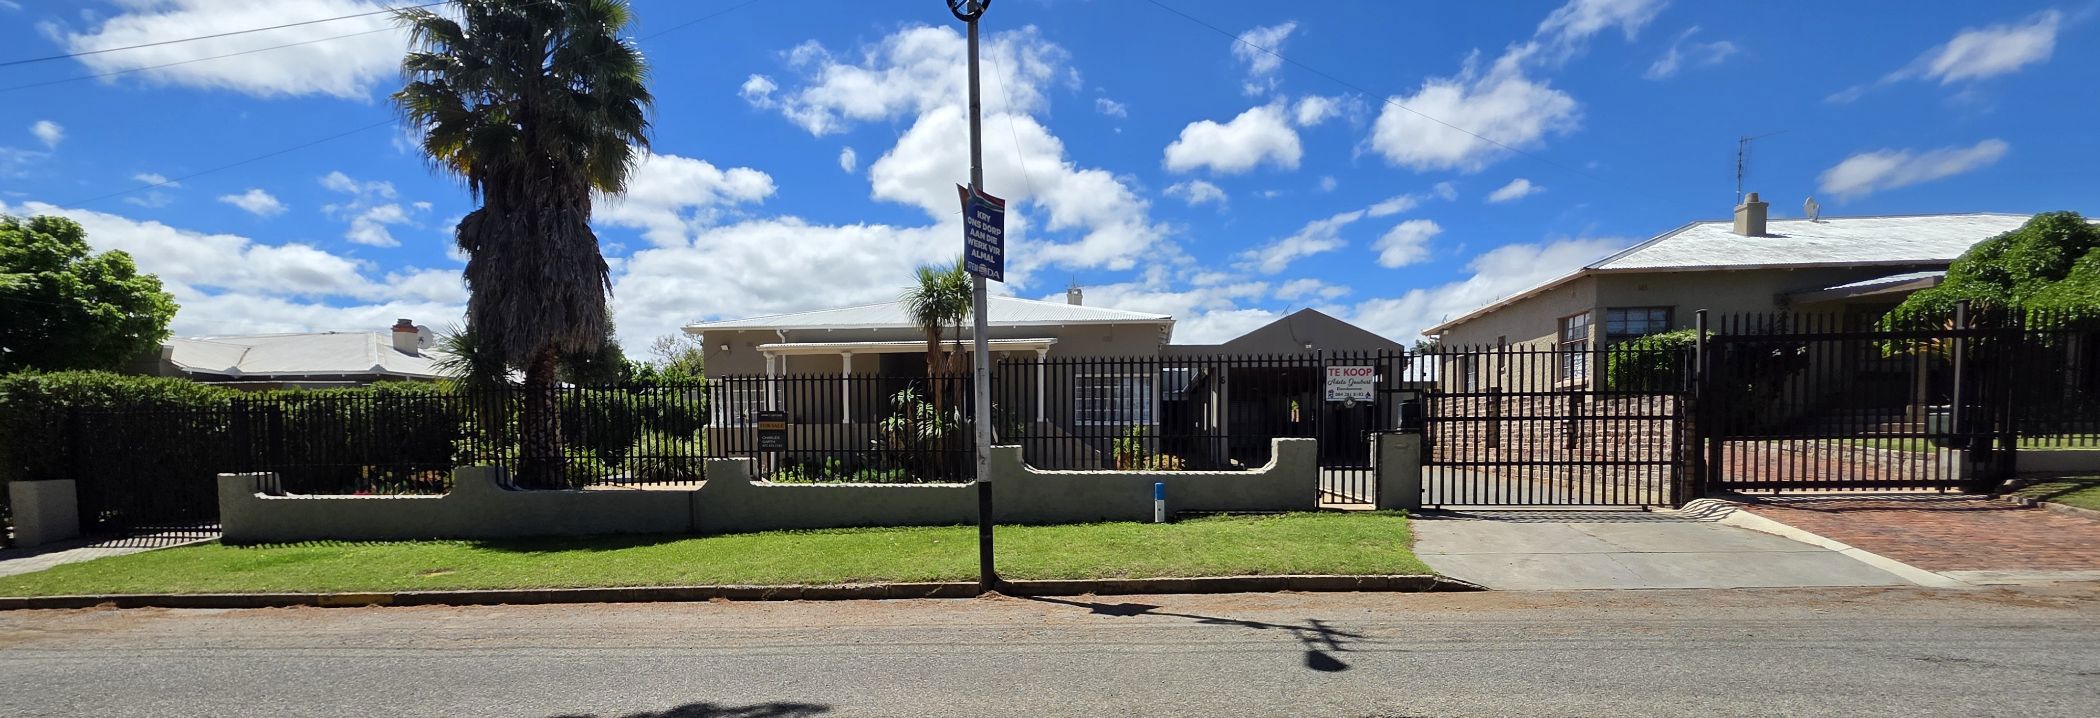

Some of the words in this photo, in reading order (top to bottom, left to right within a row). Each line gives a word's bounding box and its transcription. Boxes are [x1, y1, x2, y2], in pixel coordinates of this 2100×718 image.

[977, 210, 991, 222] KRY
[967, 216, 981, 229] ONS
[982, 222, 1001, 236] DORP
[970, 228, 985, 241] AAN
[986, 234, 998, 245] DIE
[967, 236, 987, 252] WERK
[988, 244, 1000, 255] VIR
[971, 248, 995, 264] ALMAL
[987, 268, 1000, 279] DA
[1328, 368, 1341, 376] TE
[1343, 368, 1372, 376] KOOP
